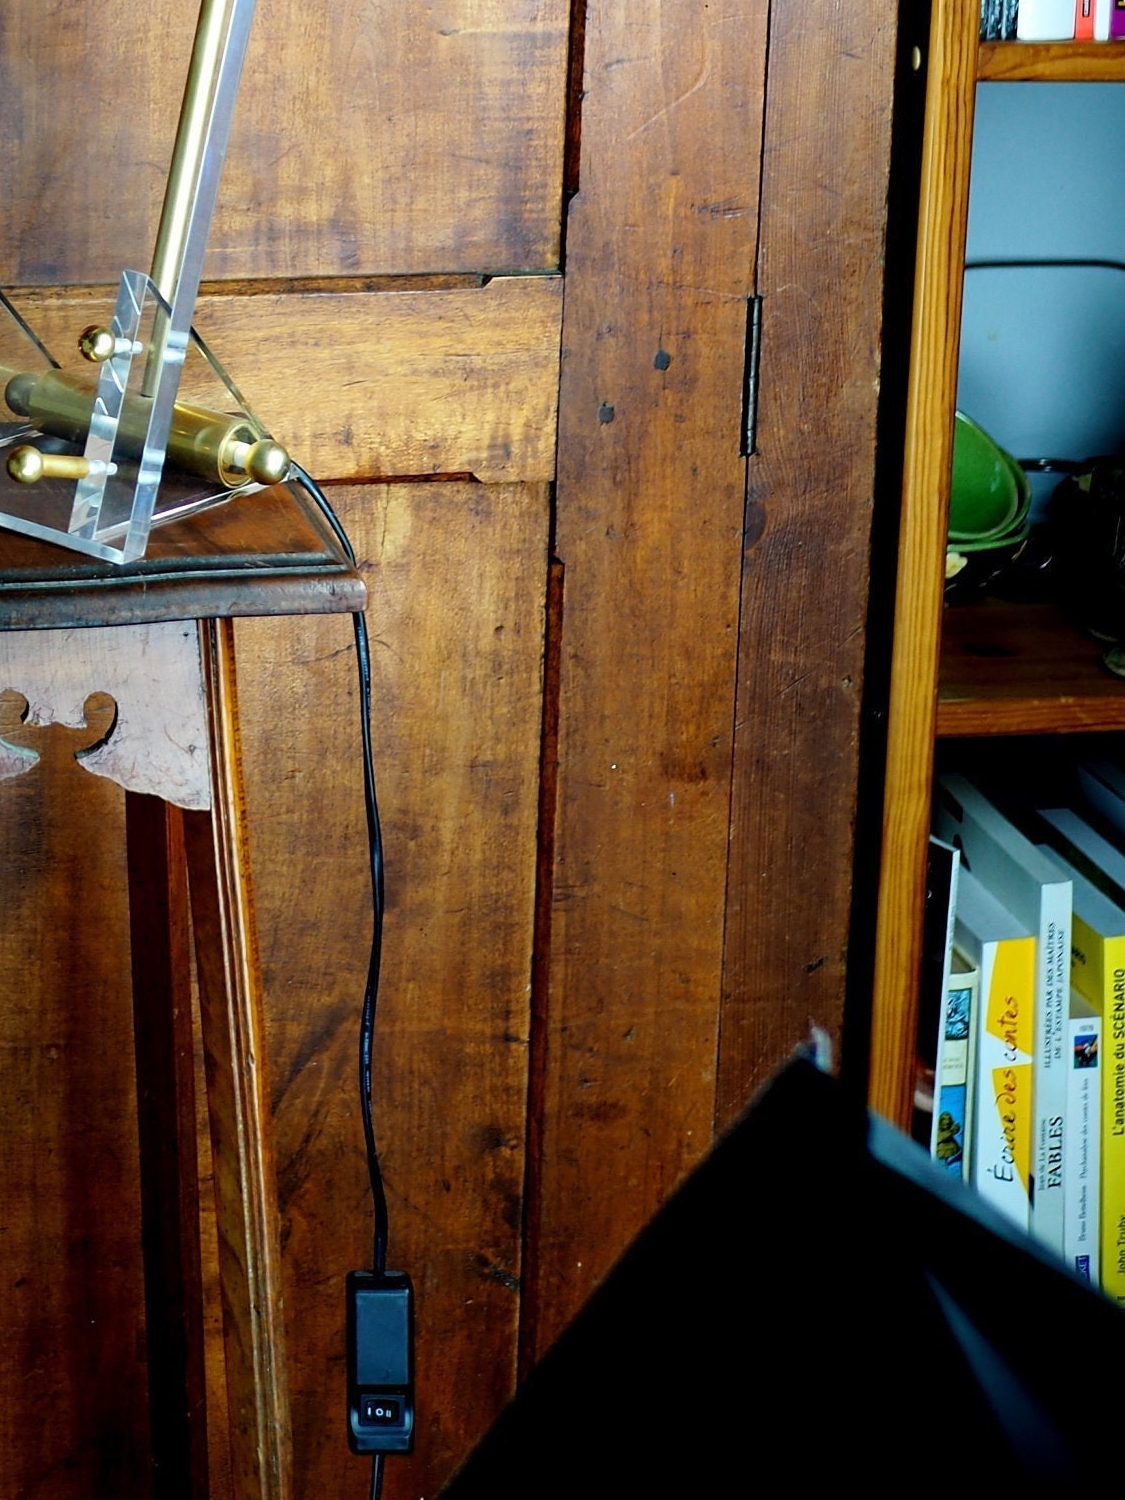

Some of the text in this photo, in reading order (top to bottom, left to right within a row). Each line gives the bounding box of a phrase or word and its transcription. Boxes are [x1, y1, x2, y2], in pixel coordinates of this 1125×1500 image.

[1045, 990, 1053, 1008] PAR
[1054, 1048, 1061, 1059] DE
[1110, 969, 1125, 1136] L'anatomie du SCÉNARIO
[986, 996, 1018, 1182] Écrire des contes
[1047, 1116, 1063, 1188] FABLES
